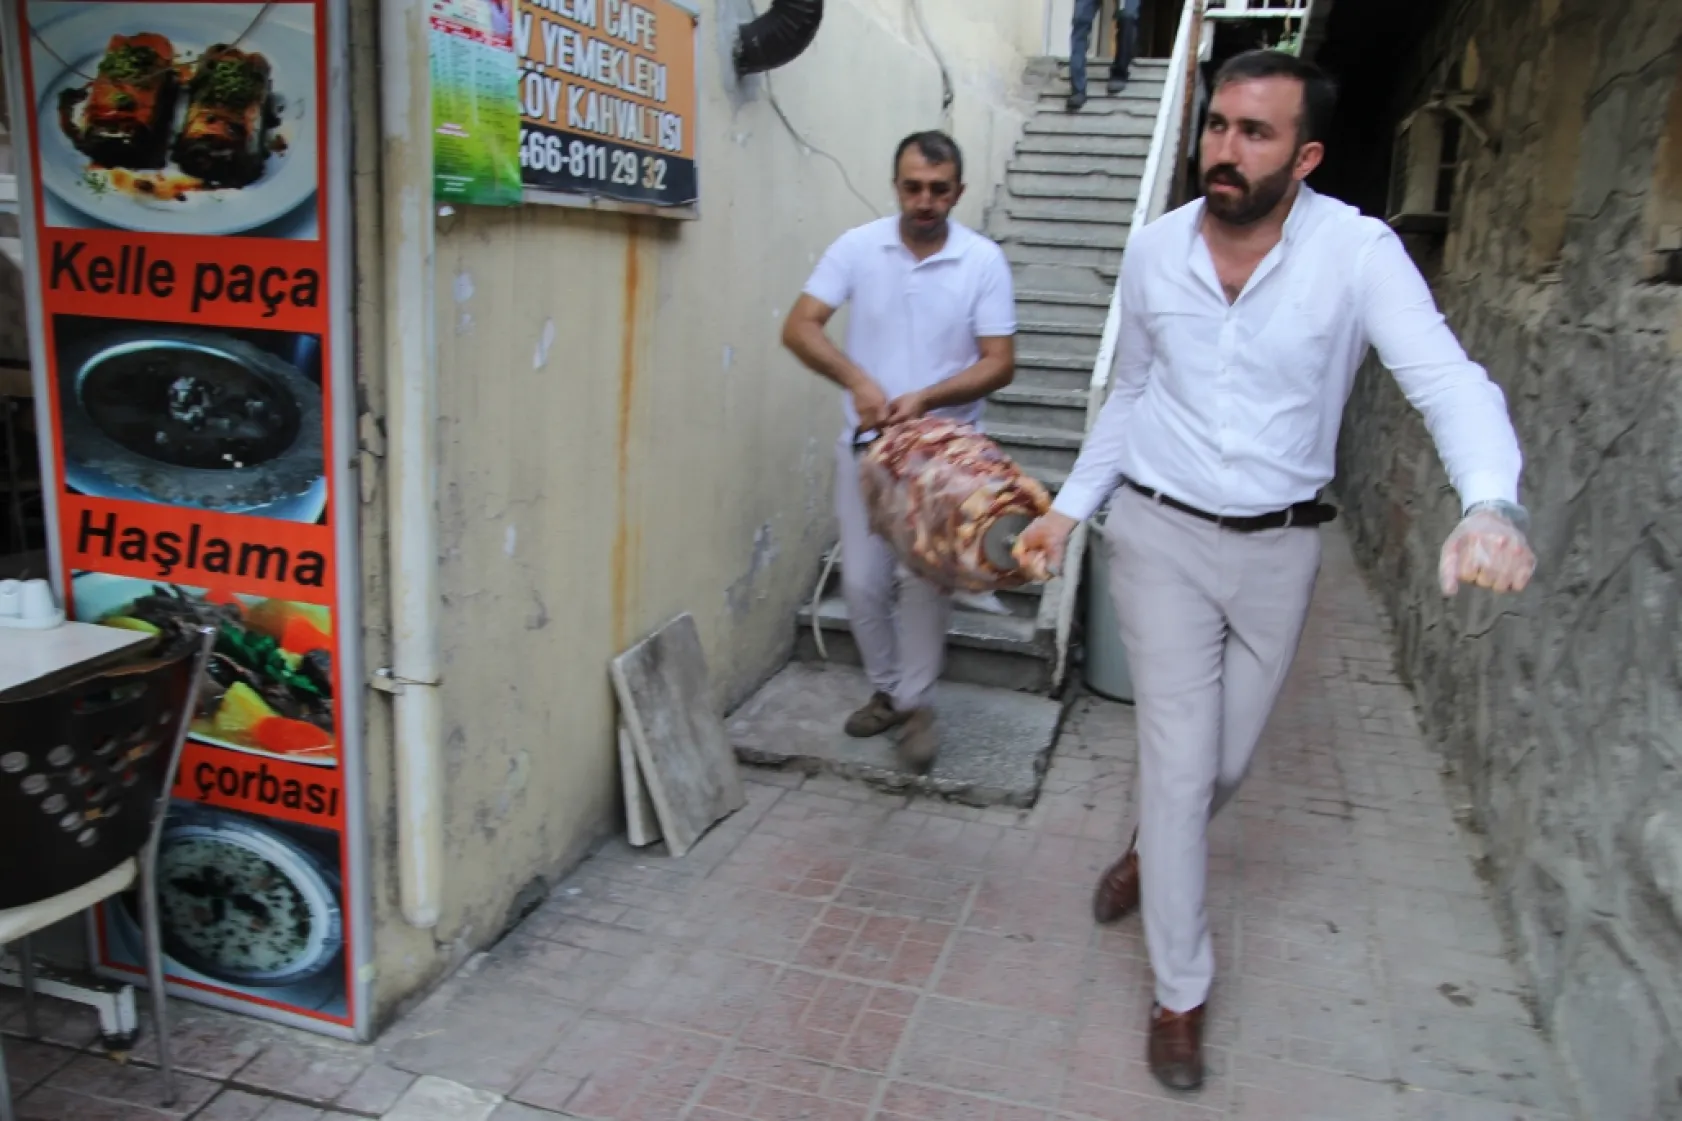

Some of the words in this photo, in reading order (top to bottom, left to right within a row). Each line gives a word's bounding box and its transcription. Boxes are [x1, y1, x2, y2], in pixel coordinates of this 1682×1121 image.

[603, 0, 657, 51] CAFE
[567, 85, 683, 151] KAHVALTISI
[611, 149, 638, 186] 29
[641, 155, 668, 191] 32
[49, 240, 176, 298] Kelle
[189, 261, 320, 318] paça
[77, 509, 327, 587] Haşlama
[195, 761, 340, 817] çorbası
